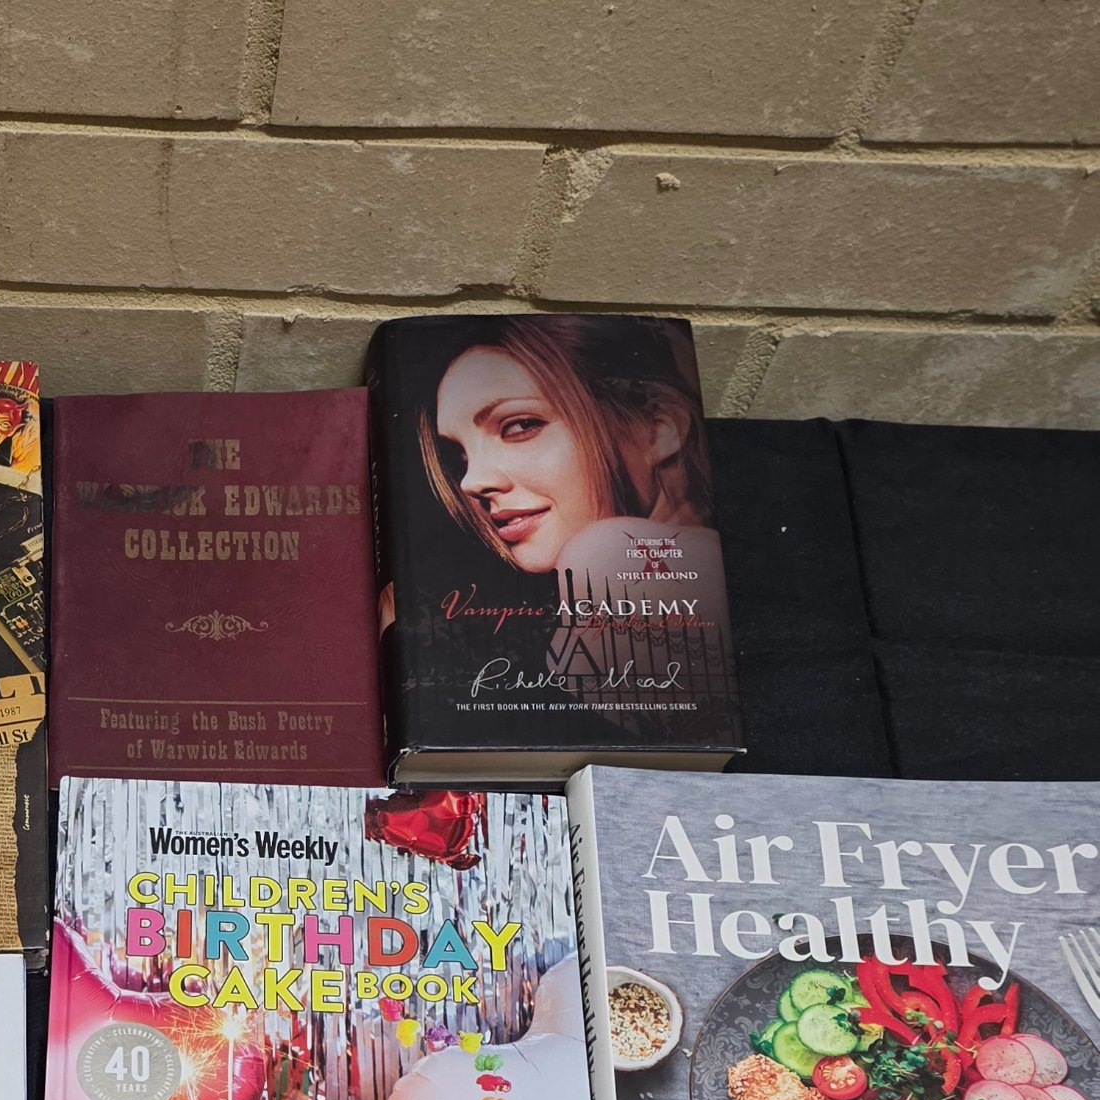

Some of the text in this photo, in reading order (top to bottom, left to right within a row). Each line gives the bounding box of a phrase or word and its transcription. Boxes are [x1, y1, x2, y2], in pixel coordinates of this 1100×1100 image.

[225, 485, 362, 516] EDWARDS
[124, 528, 300, 561] COLLECTION
[626, 549, 683, 559] FIRST CHAPTER
[630, 538, 676, 546] FEATURING THE
[616, 571, 698, 580] SPIRIT BOUND
[652, 560, 660, 569] OF
[441, 584, 545, 635] Vampire
[556, 599, 699, 616] ACADEMY
[471, 657, 684, 698] Richelle Mead
[0, 707, 21, 718] 1987
[100, 708, 334, 735] Featuring the Bush Poetry
[456, 703, 697, 711] THE FIRST BOOK IN THE NEW YORK TIMES BESTSELLING SERIES
[12, 729, 29, 743] St
[127, 739, 308, 761] of Warwick Edwards
[149, 827, 339, 867] Women's Weekly
[640, 813, 1099, 915] Air Fryer
[128, 871, 430, 915] CHILDREN'S
[127, 907, 522, 971] BIRTHDAY
[642, 889, 1026, 991] Healthy
[168, 963, 480, 1013] CAKE BOOK
[105, 1045, 150, 1082] 40
[116, 1083, 148, 1093] YEARS
